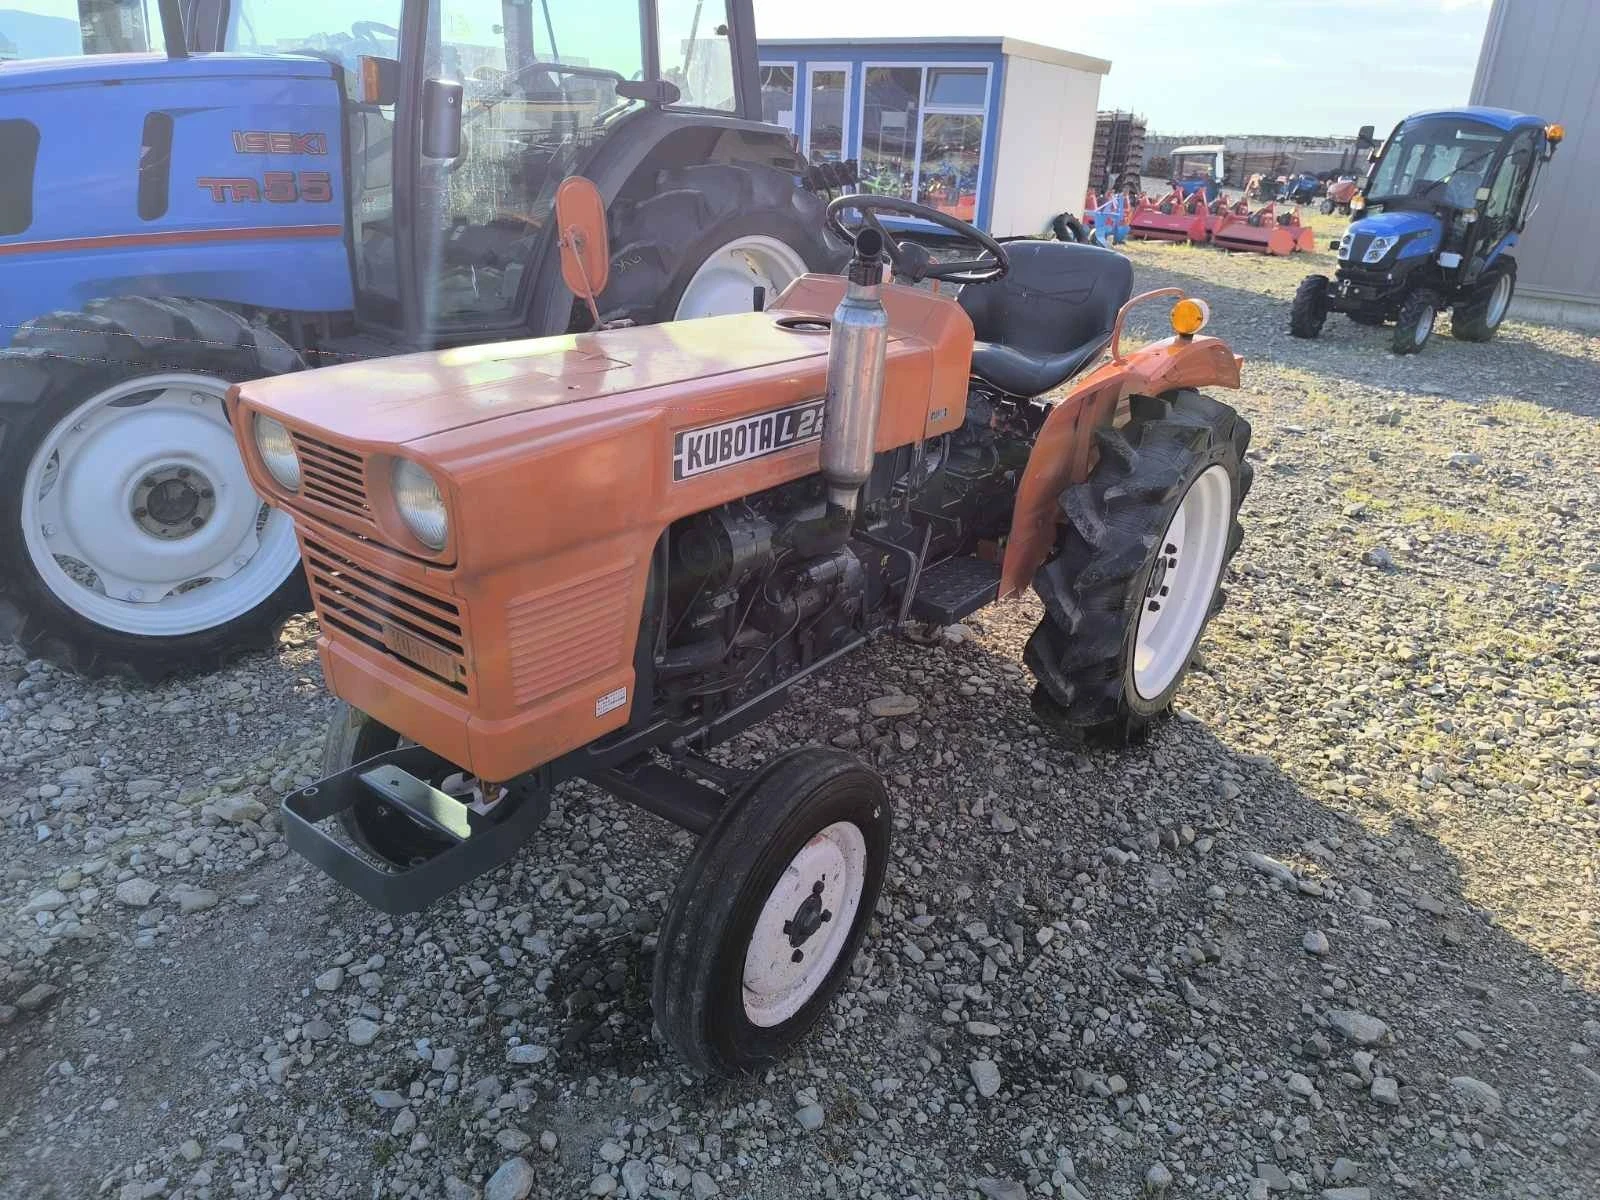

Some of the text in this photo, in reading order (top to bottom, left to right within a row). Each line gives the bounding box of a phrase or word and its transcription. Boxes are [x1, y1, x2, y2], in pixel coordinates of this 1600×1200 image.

[232, 130, 328, 155] ISEKI
[197, 170, 333, 203] TA55
[687, 417, 773, 471] KUBOTA
